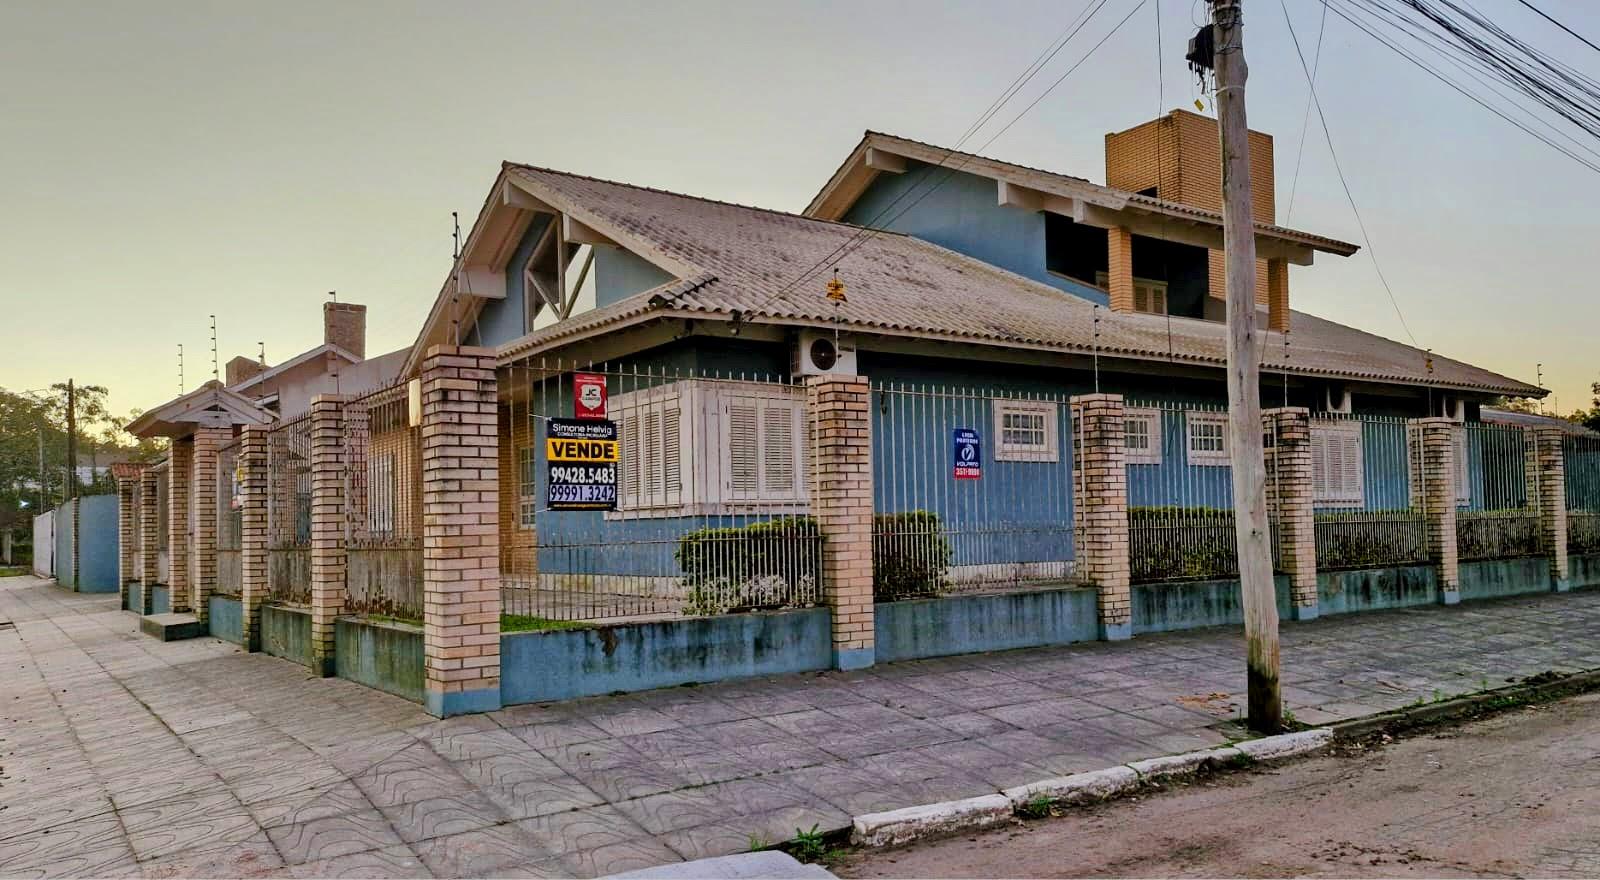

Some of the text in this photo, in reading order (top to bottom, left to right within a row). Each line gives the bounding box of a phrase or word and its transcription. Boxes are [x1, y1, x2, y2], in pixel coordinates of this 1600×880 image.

[552, 423, 612, 436] Simone Helvig
[551, 441, 615, 459] VENDE
[551, 466, 615, 484] 99428.5483
[551, 485, 615, 501] 99991.3242
